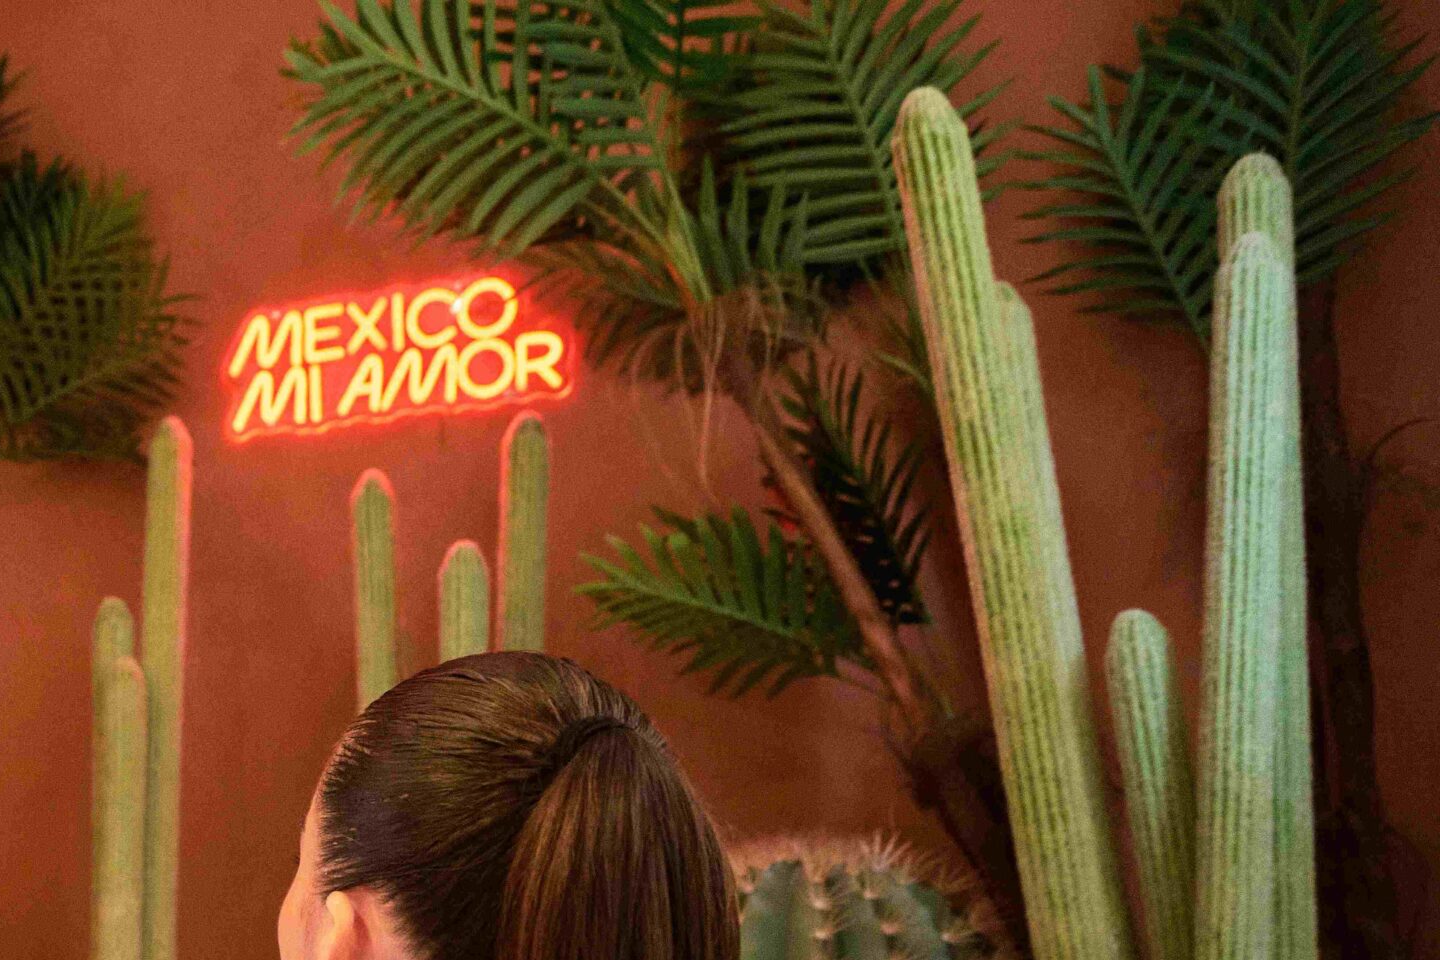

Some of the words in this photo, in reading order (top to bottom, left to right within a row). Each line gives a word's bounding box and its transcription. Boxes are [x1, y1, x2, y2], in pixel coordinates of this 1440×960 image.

[229, 277, 518, 377] MEXICO
[232, 365, 323, 432] MI
[337, 331, 563, 416] AMOR
